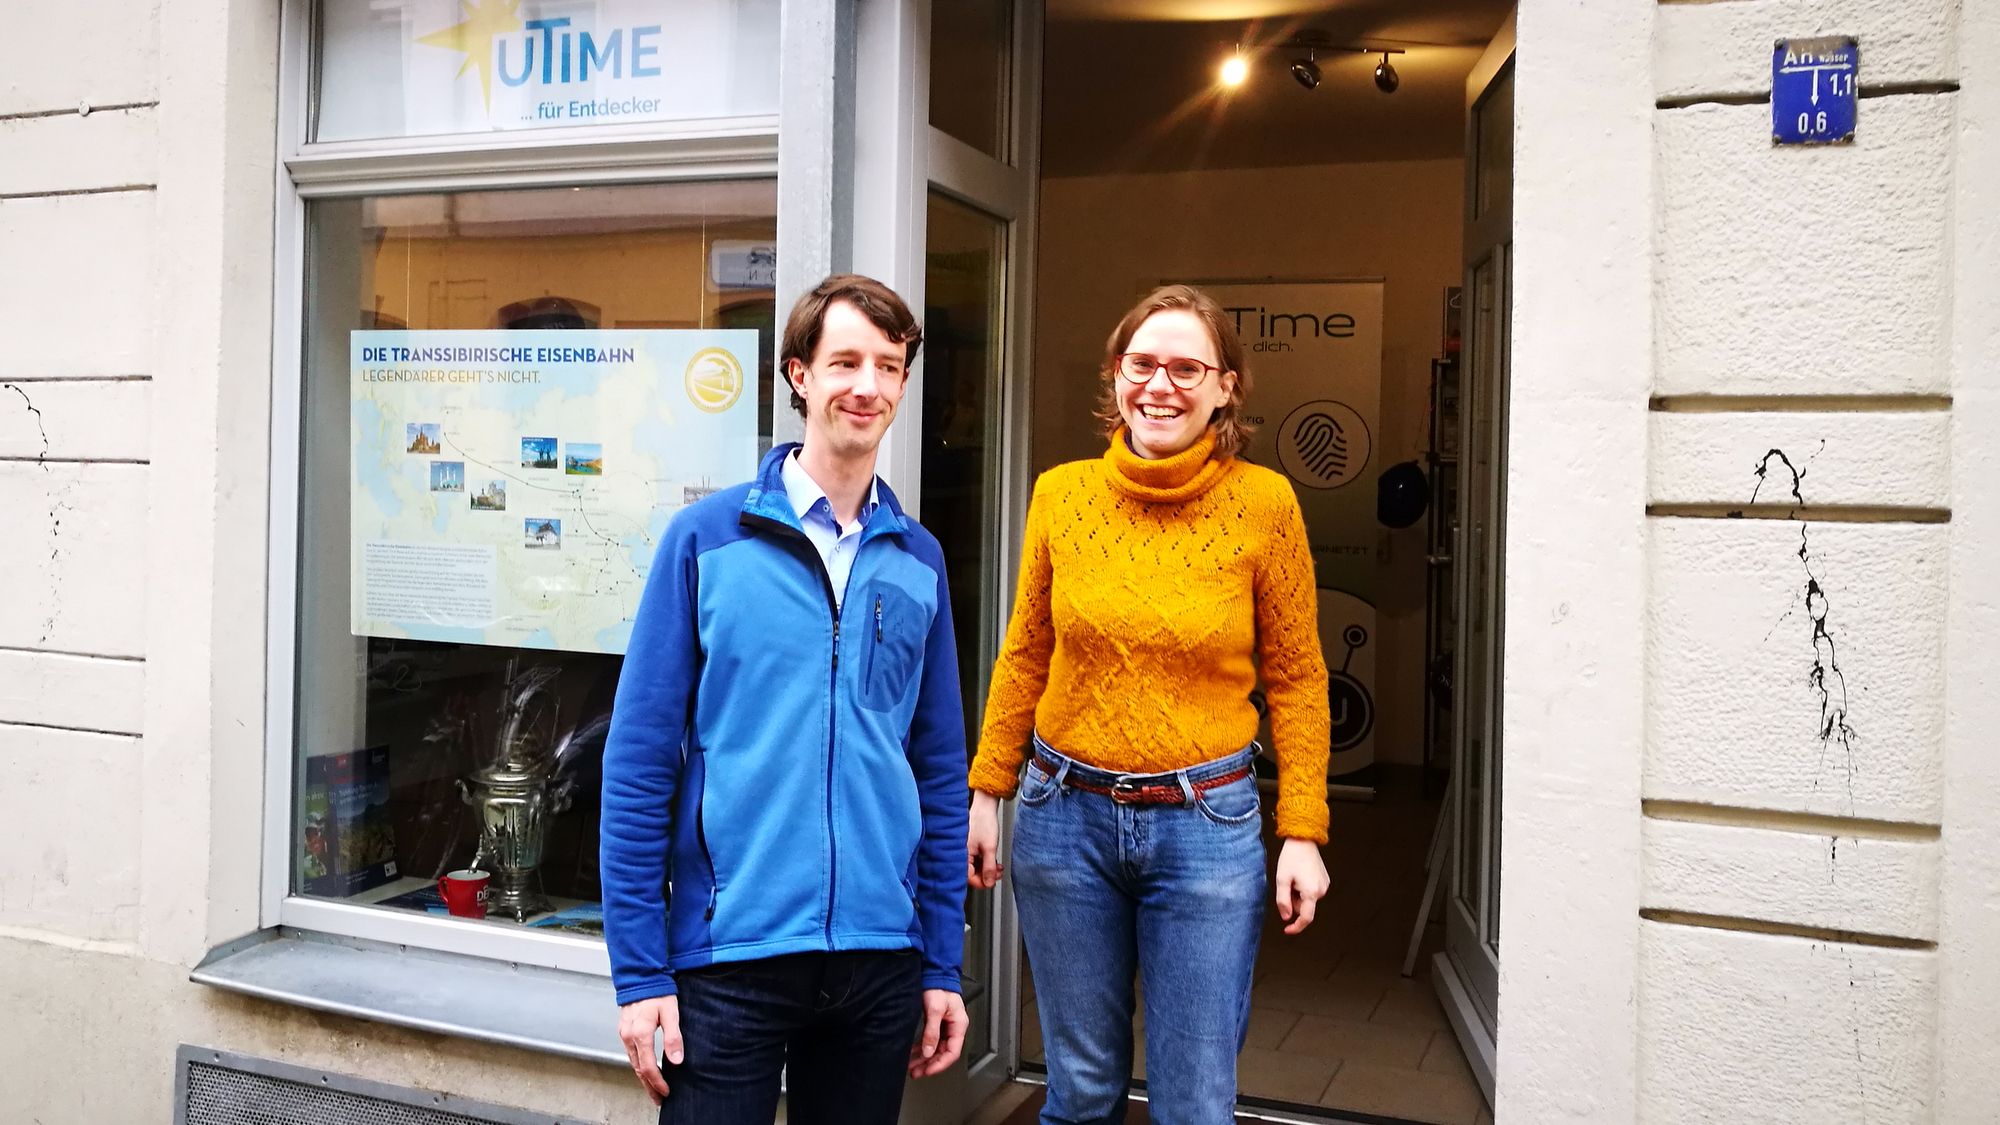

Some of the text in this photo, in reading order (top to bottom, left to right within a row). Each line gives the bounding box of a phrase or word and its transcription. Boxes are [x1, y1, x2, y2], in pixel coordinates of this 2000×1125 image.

[1830, 73, 1852, 97] 1,1
[538, 102, 564, 119] für
[569, 97, 661, 117] Entdecker
[1798, 111, 1827, 135] 0,6
[363, 347, 635, 363] DIE TRANSSIBIRISCHE EISENBAHN
[1253, 341, 1294, 352] dich.
[362, 369, 541, 383] LEGENDÄRER GEHT'S NICHT.
